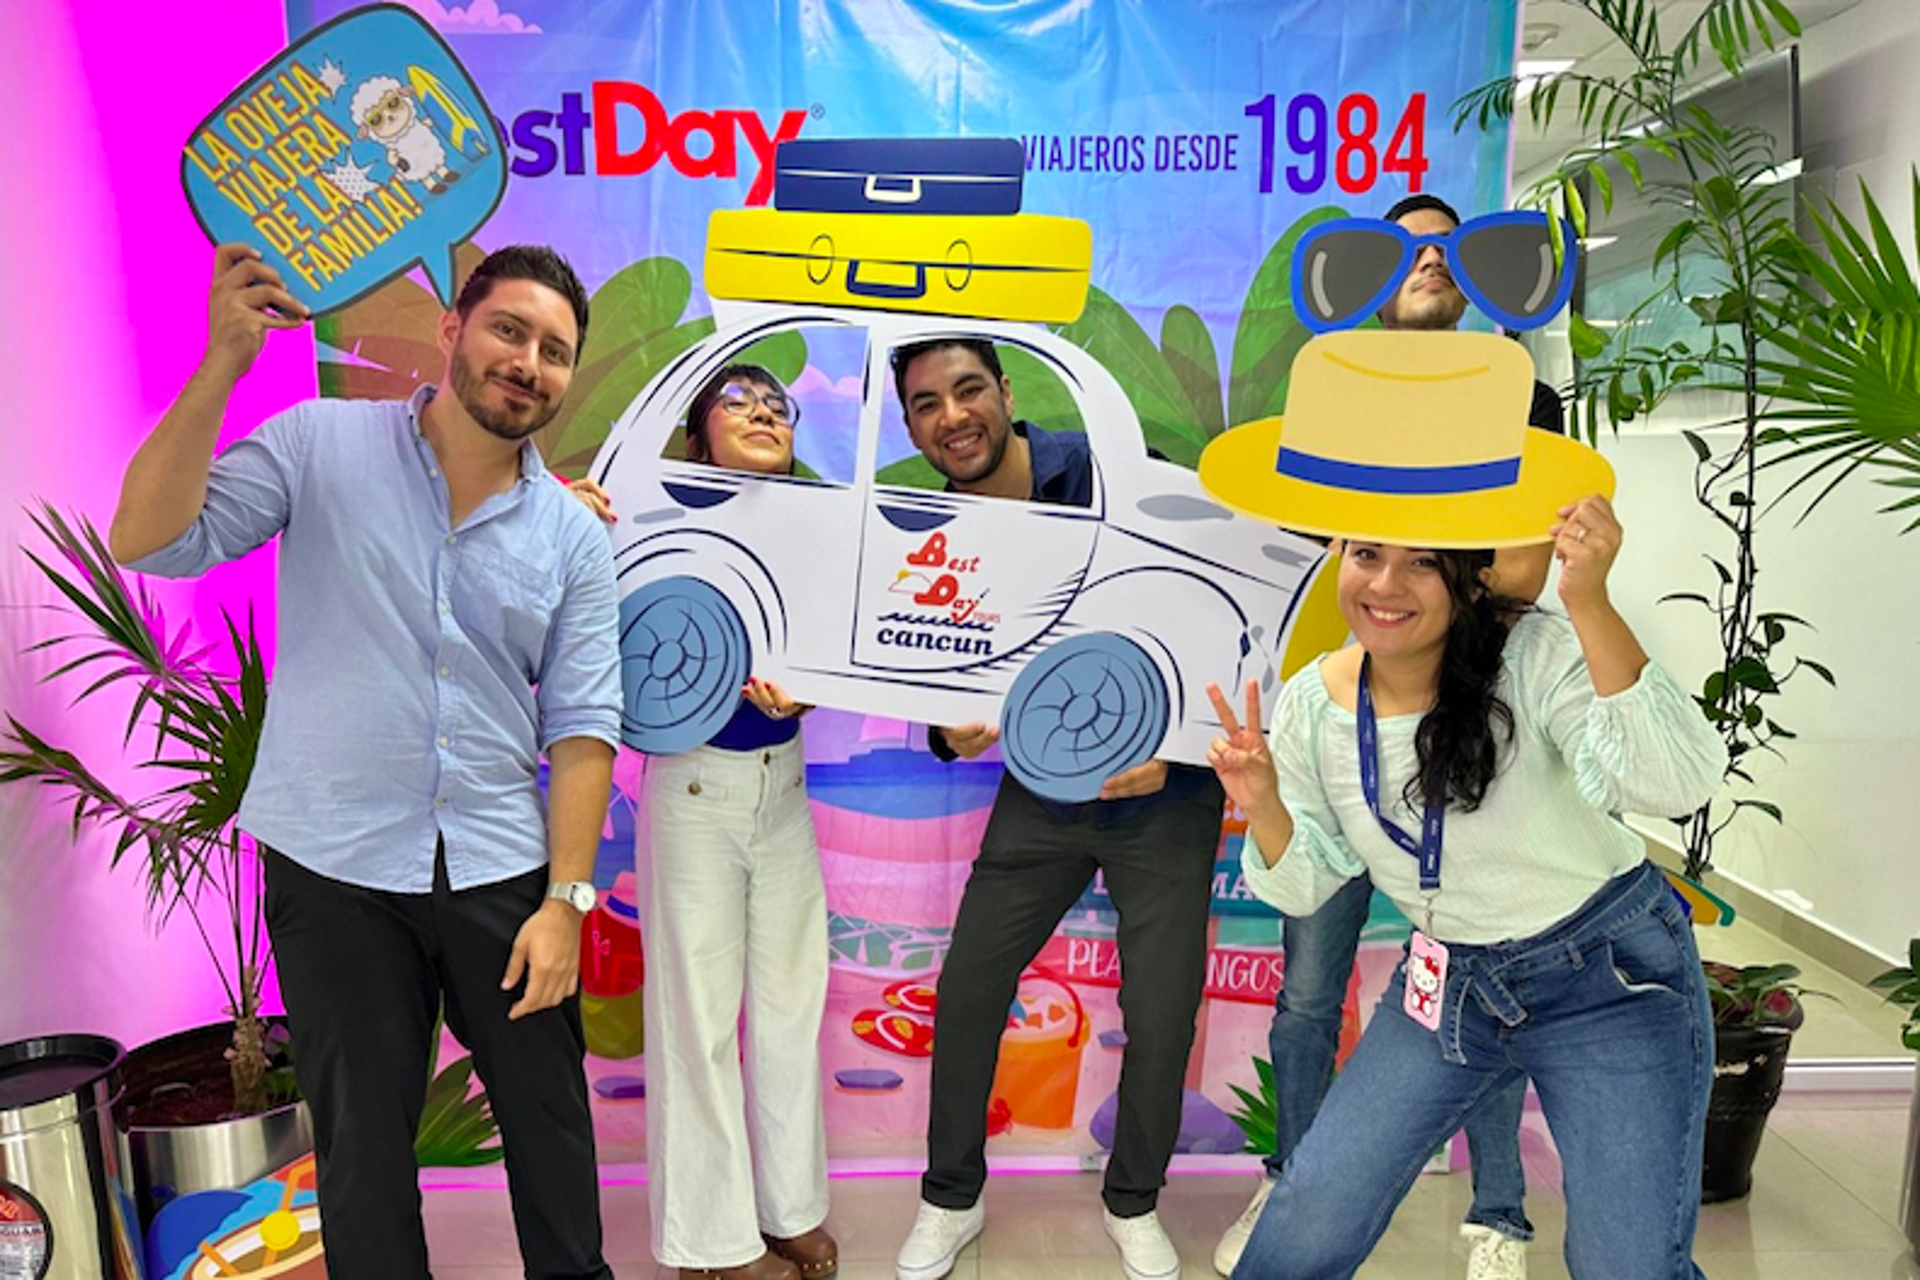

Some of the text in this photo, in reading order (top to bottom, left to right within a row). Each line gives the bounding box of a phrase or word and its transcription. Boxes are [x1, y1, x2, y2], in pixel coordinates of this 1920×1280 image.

[184, 59, 332, 183] LA OVEJA
[217, 111, 351, 217] VIAJERA
[1021, 92, 1430, 195] VIAJEROS DESDE 1984
[253, 170, 354, 255] DE LA
[288, 175, 425, 292] FAMILIA!
[906, 531, 981, 573] Best
[913, 573, 980, 623] Day
[876, 627, 994, 656] cancun
